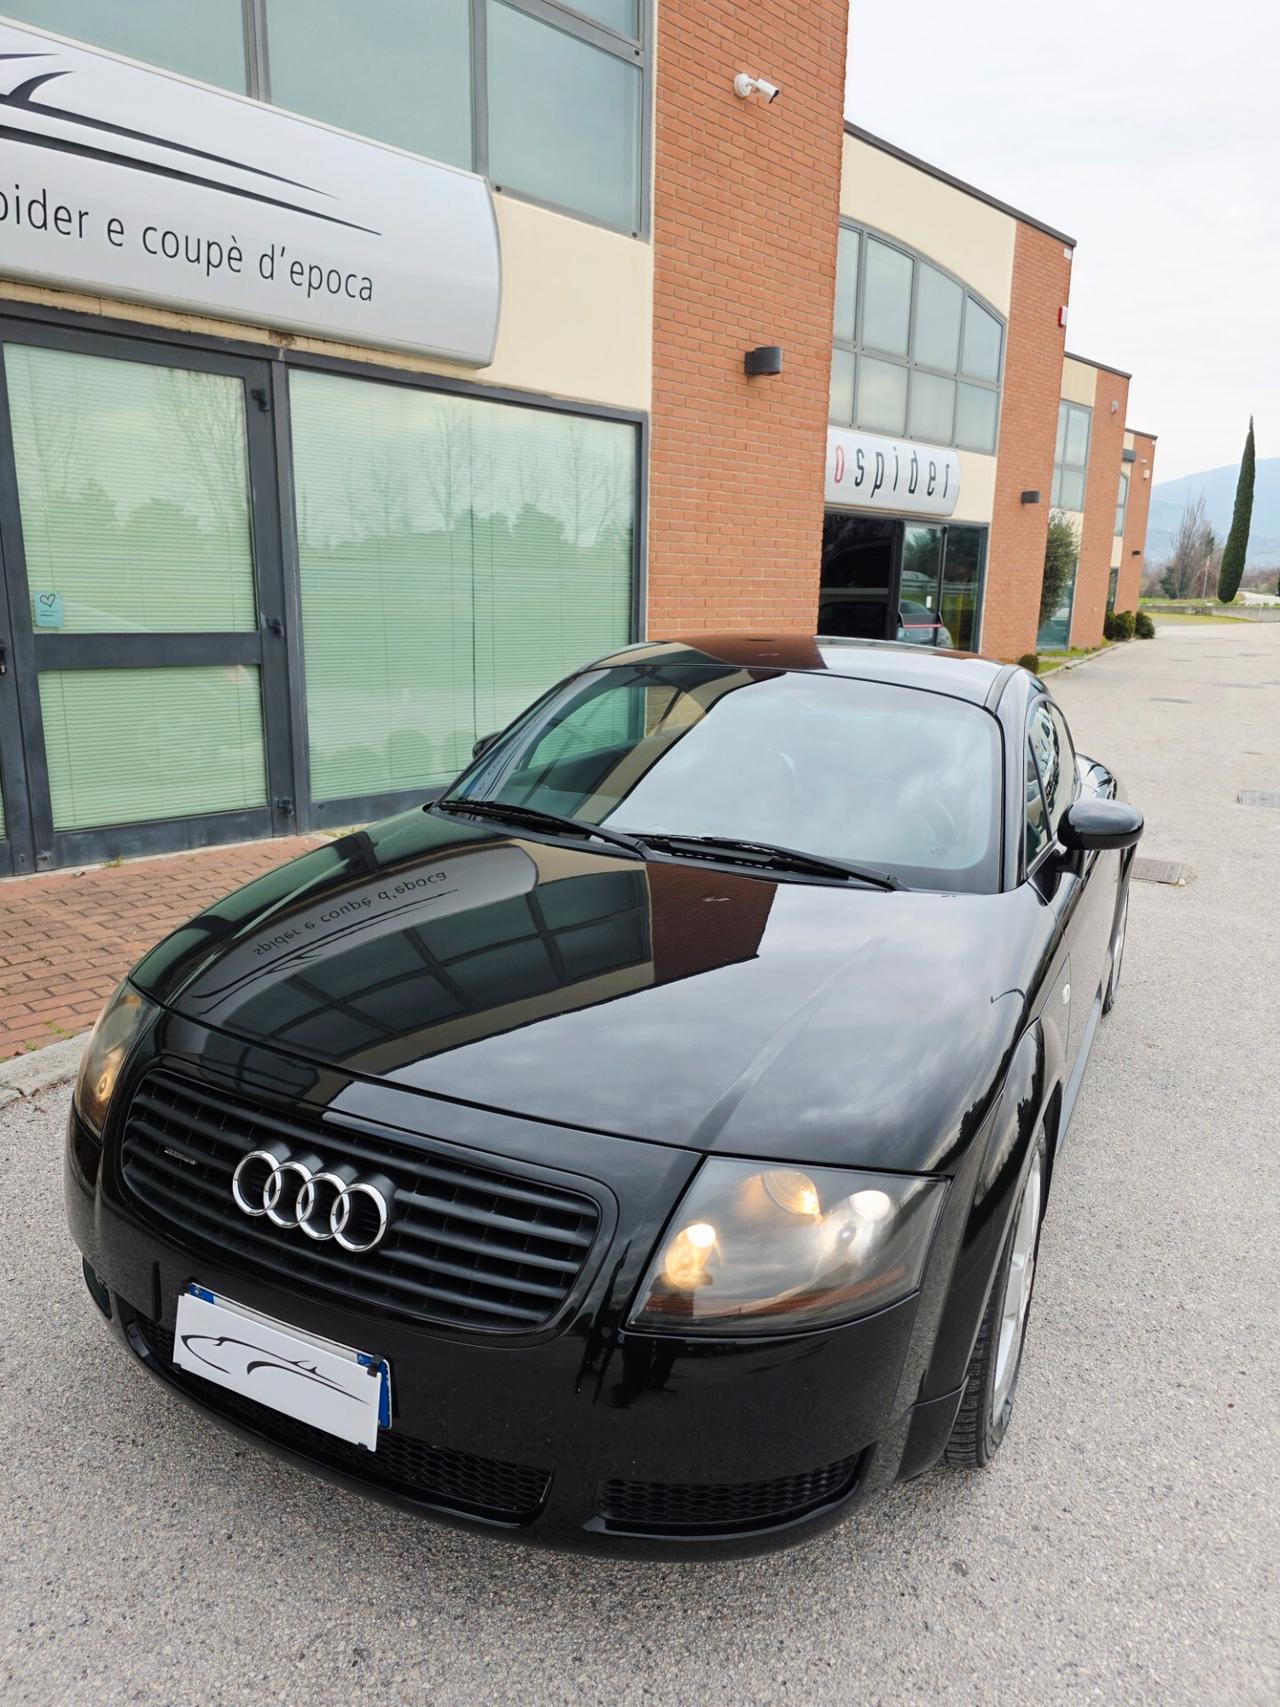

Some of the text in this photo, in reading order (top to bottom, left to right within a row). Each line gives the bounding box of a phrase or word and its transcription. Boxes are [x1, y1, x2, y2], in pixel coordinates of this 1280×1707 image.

[107, 216, 125, 247] e
[142, 225, 243, 277] coupè
[259, 243, 373, 302] d’epoca
[834, 445, 950, 498] ospider
